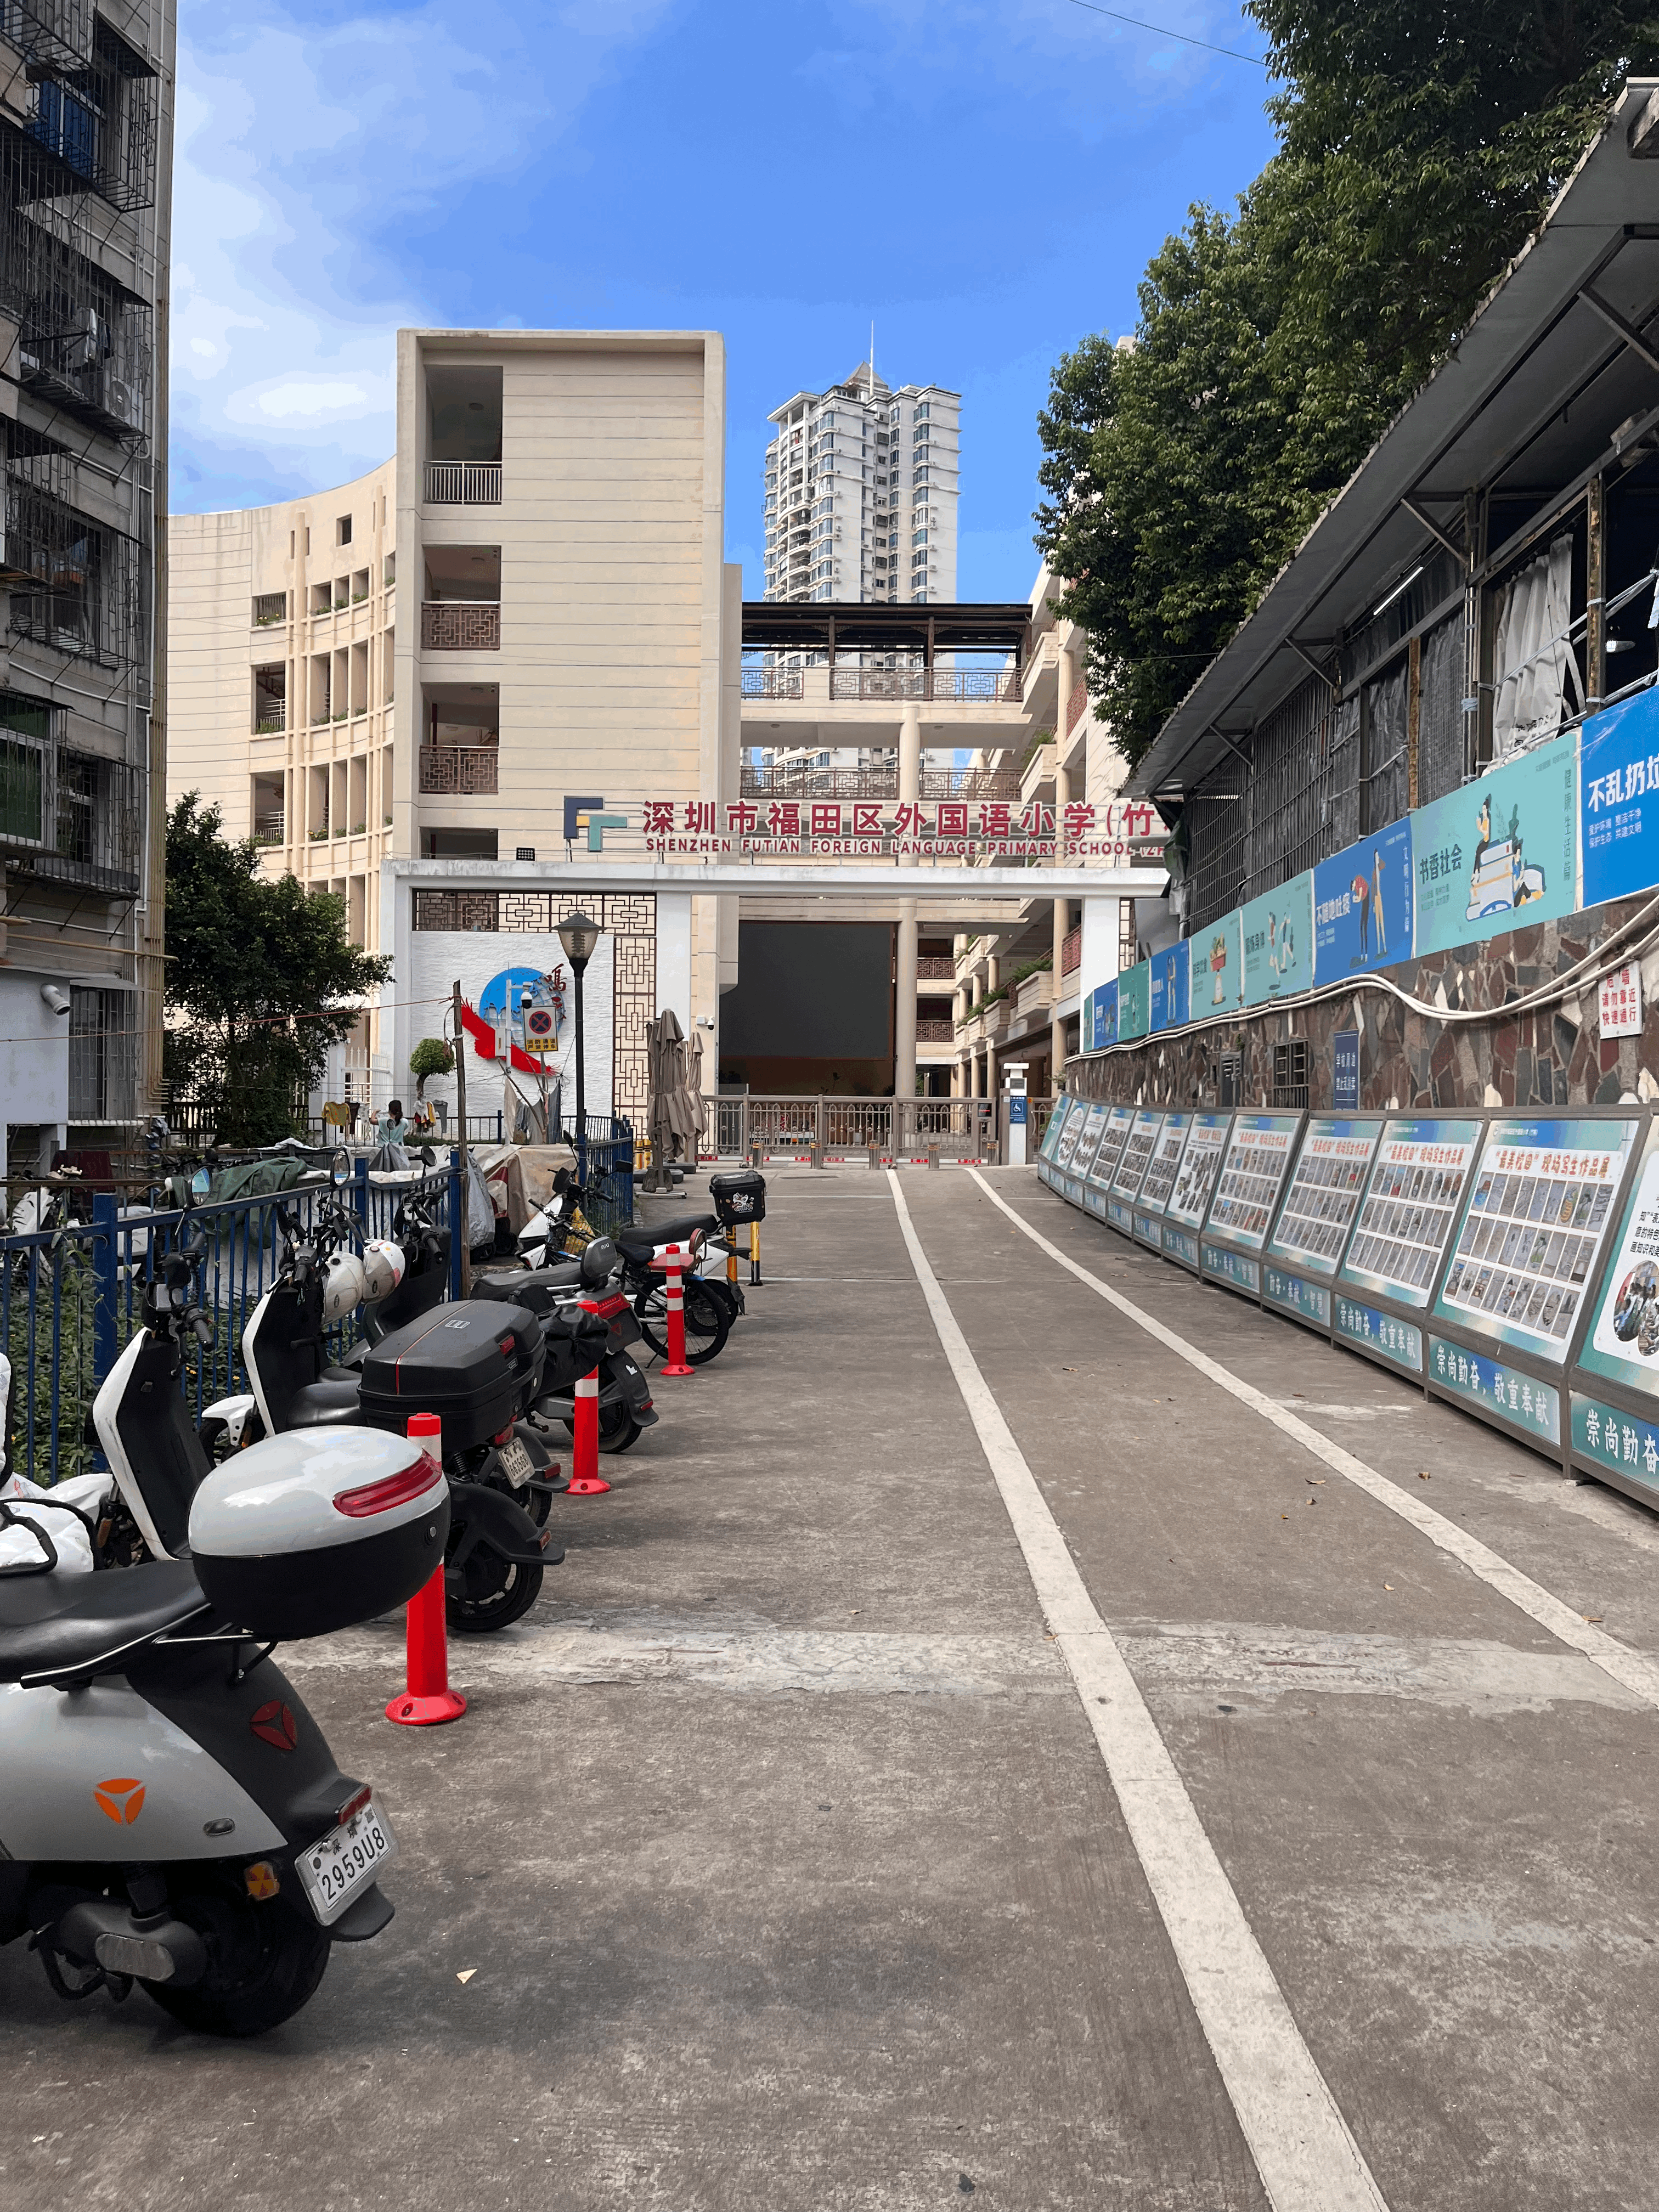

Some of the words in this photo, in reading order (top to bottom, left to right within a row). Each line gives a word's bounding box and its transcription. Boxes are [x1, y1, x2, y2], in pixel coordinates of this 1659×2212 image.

[642, 801, 1169, 837] 深圳市福田区外国语小学(竹
[646, 839, 730, 851] SHENZHEN
[743, 839, 799, 853] FUTIAN
[812, 840, 881, 853] FOREIGN
[893, 841, 975, 854] LANGUAGE
[988, 842, 1057, 855] PRIMARY
[1069, 842, 1132, 855] SCHOOL
[1420, 843, 1462, 885] 书香社会
[1602, 988, 1636, 1007] 请勿靠近
[1586, 1408, 1659, 1475] 崇尚勤奋
[322, 1827, 385, 1900] 2959U8
